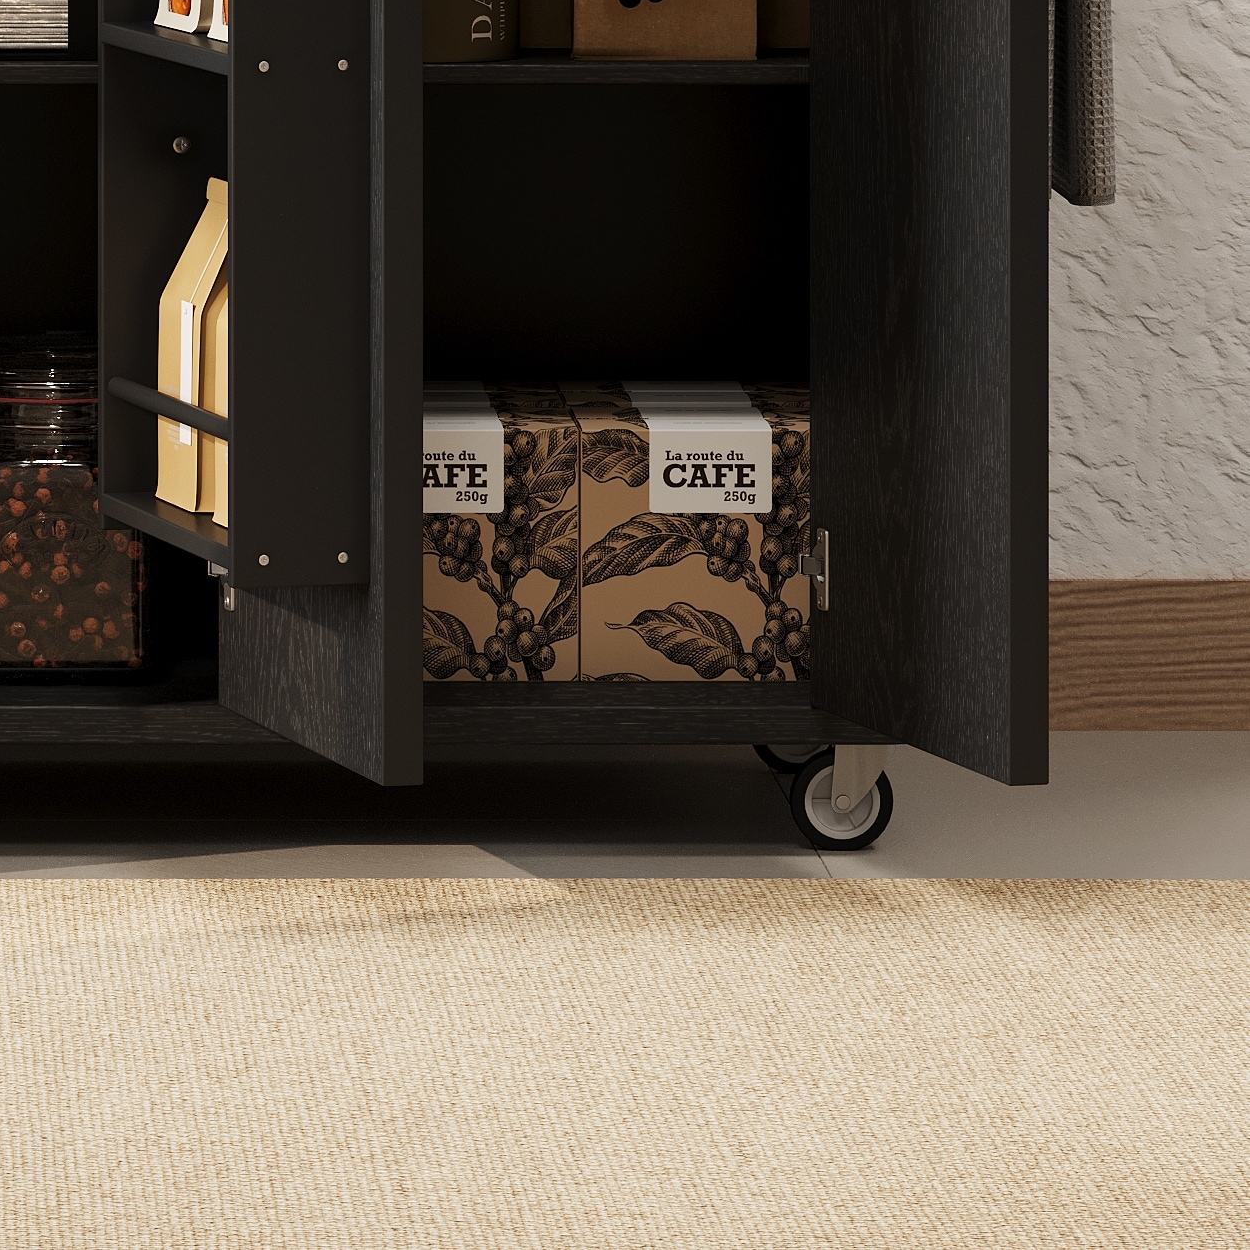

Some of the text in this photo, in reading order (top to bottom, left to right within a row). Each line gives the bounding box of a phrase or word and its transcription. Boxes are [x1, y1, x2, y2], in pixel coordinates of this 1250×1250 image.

[458, 450, 477, 461] du
[665, 450, 745, 461] La route du
[422, 463, 488, 488] AFE
[662, 463, 756, 488] CAFE
[455, 490, 489, 505] 250g
[723, 490, 757, 505] 250g
